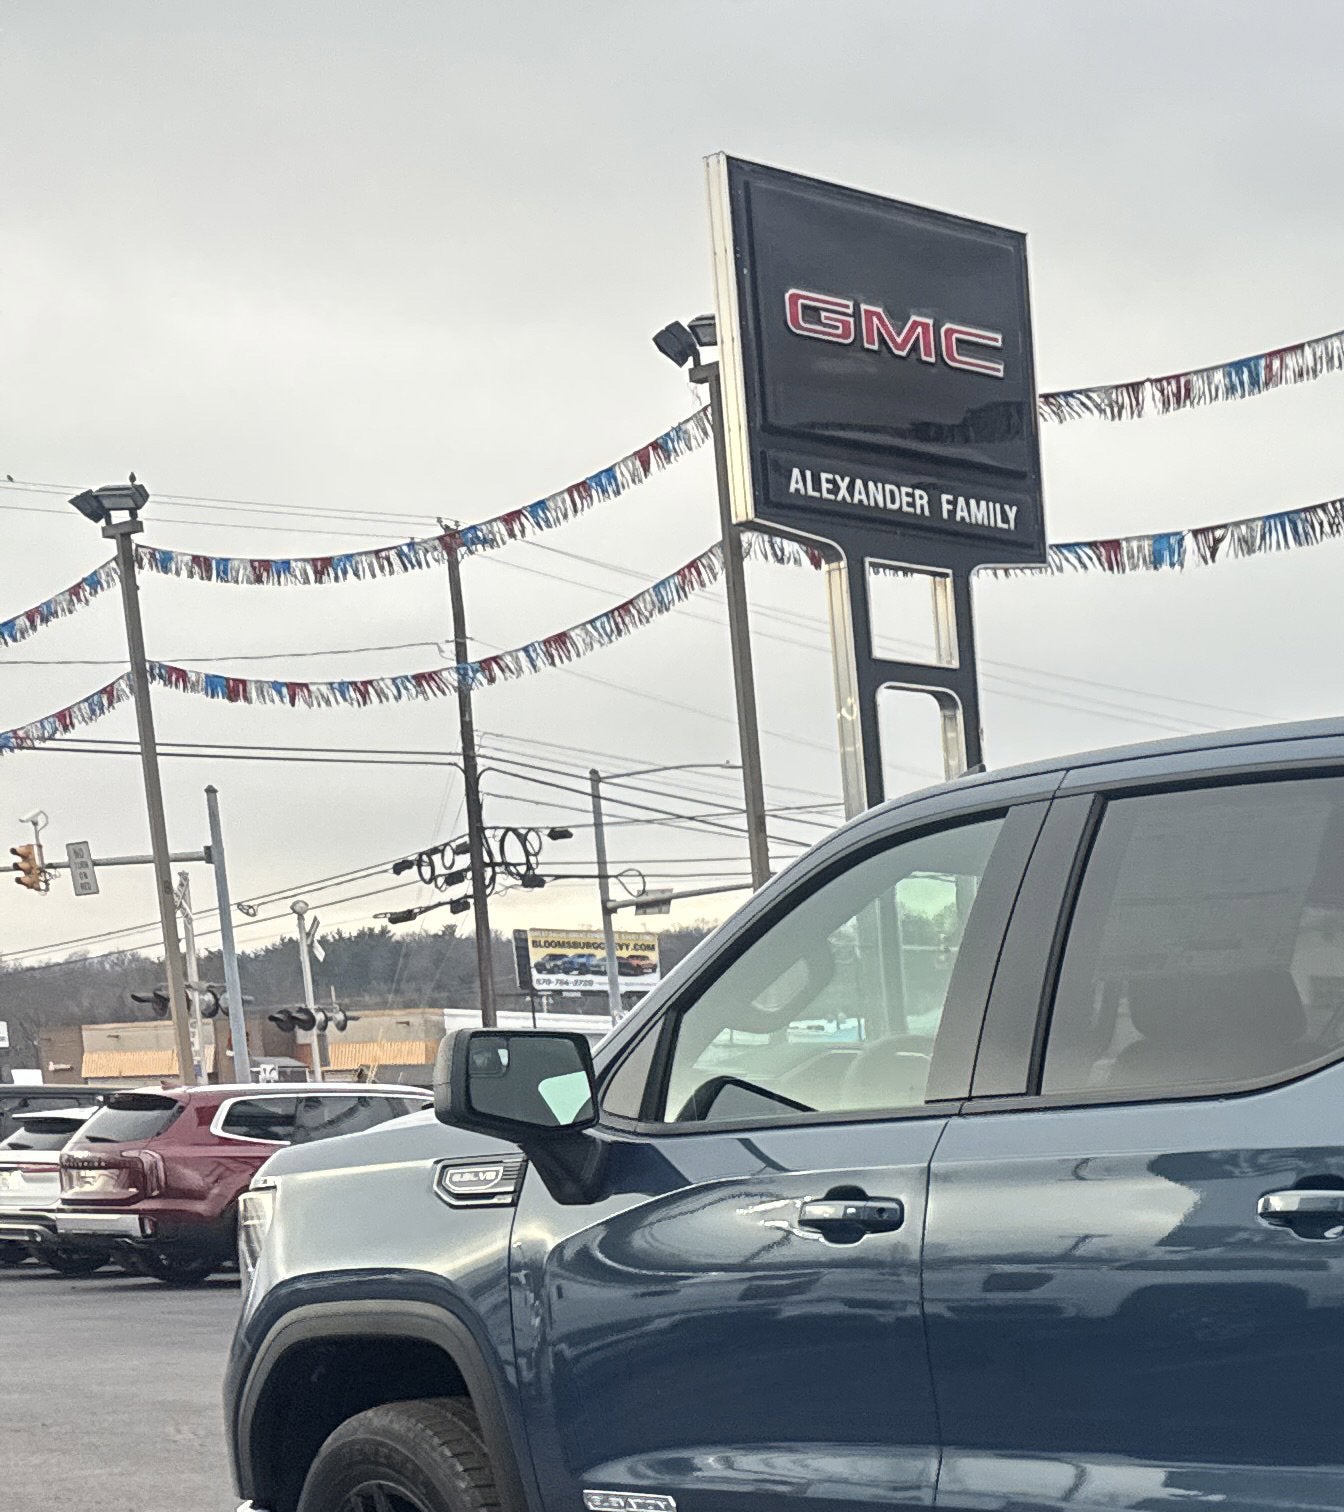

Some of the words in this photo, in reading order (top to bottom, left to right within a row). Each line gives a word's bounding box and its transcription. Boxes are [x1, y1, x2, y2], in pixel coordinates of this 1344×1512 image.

[785, 288, 1004, 378] GMC
[789, 467, 930, 517] ALEXANDER
[941, 493, 1018, 531] FAMILY
